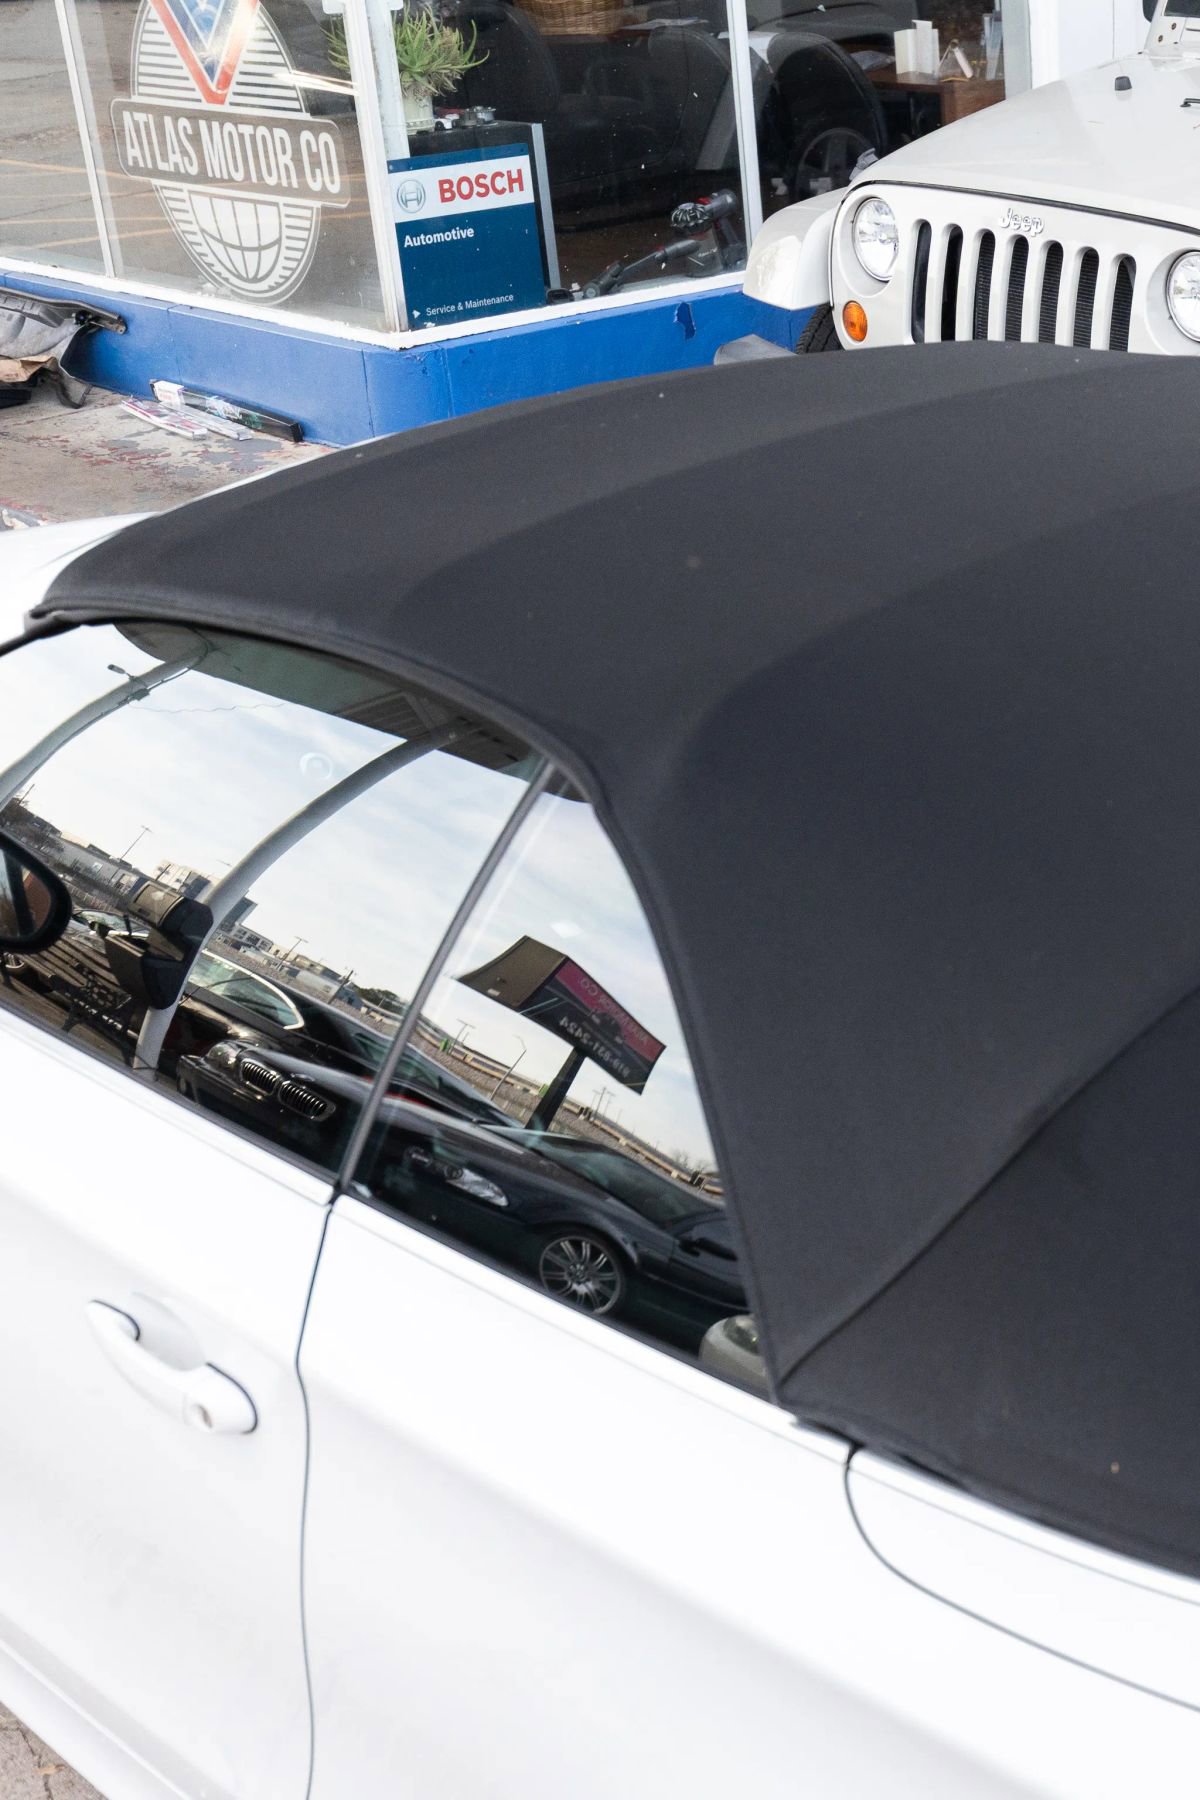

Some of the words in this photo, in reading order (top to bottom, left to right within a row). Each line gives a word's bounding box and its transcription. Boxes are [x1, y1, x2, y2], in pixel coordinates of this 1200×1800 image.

[122, 110, 199, 176] ATLAS
[198, 119, 299, 189] MOTOR
[300, 130, 341, 194] CO
[438, 168, 525, 203] BOSCH
[404, 226, 475, 248] Automotive
[999, 207, 1045, 237] Jeep
[426, 304, 456, 316] Service
[457, 301, 463, 311] &
[465, 294, 514, 308] Maintenance
